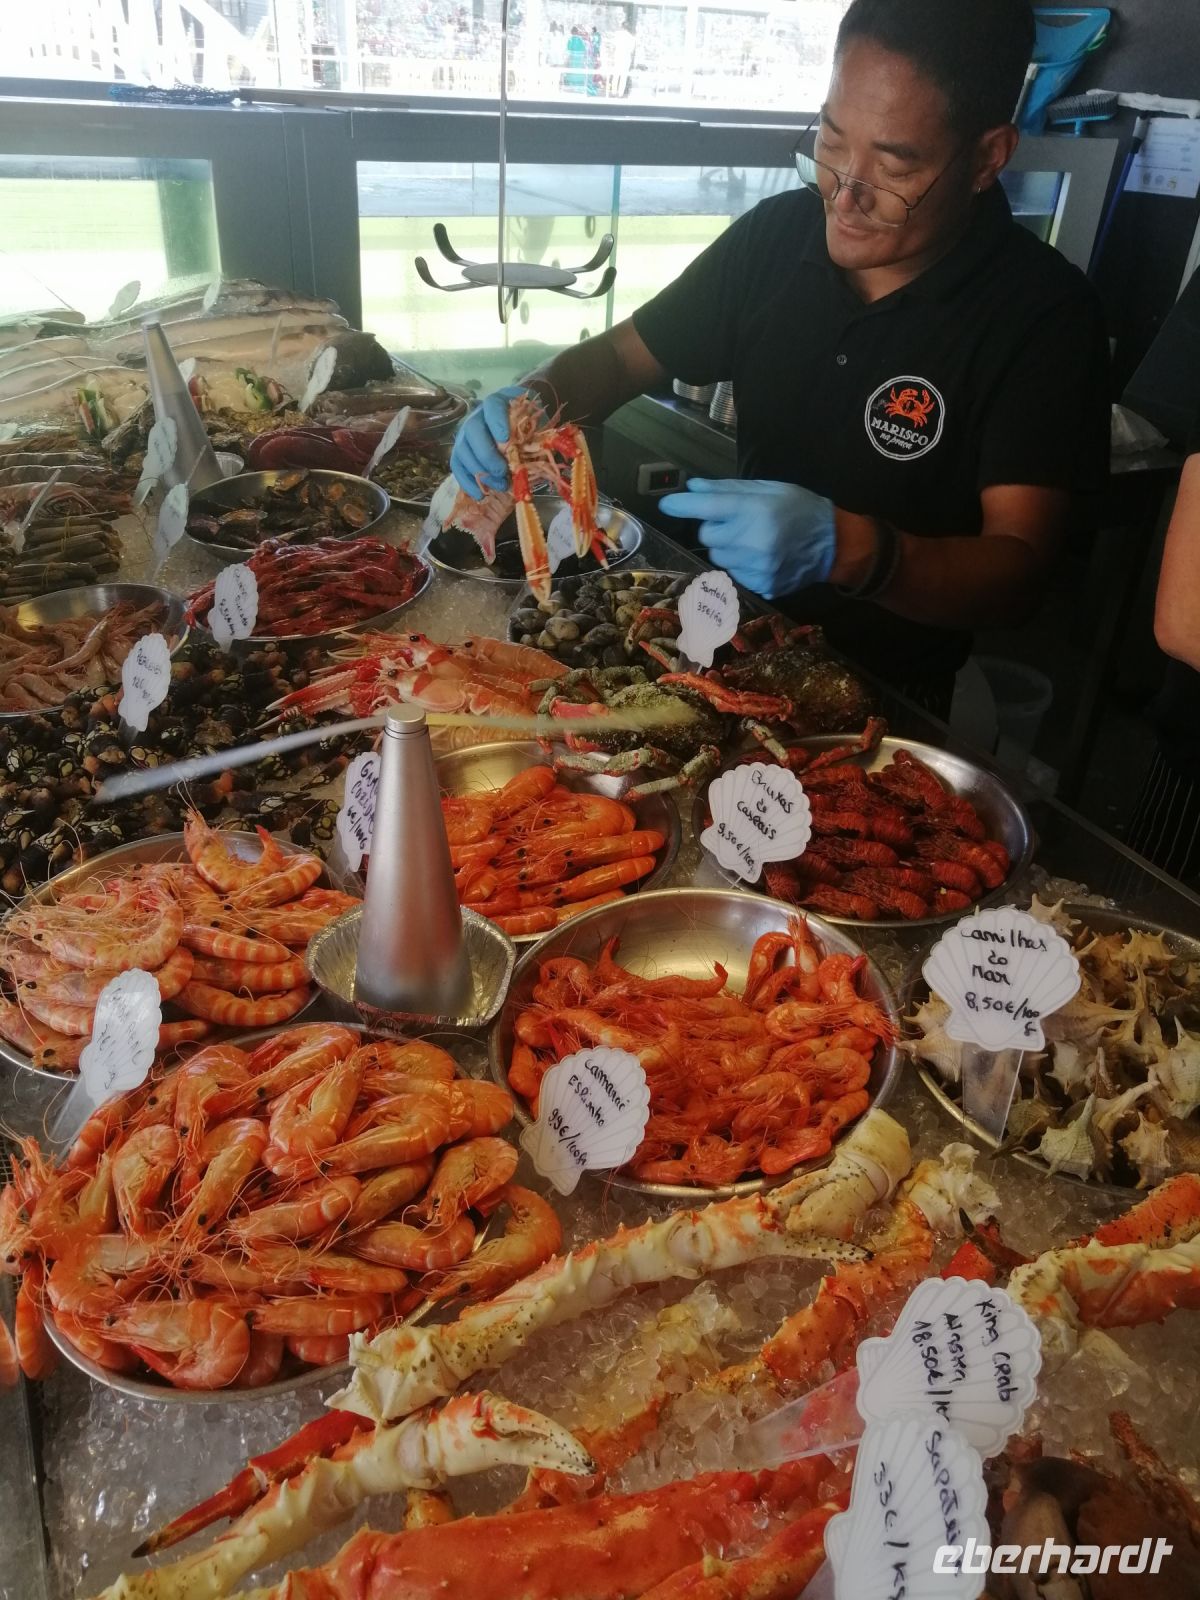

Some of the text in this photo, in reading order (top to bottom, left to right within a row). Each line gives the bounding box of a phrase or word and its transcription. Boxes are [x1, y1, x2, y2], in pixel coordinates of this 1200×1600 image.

[871, 416, 928, 446] MARISCO
[751, 769, 794, 814] Bruxas
[972, 964, 1011, 986] Mar
[975, 1298, 1003, 1347] King
